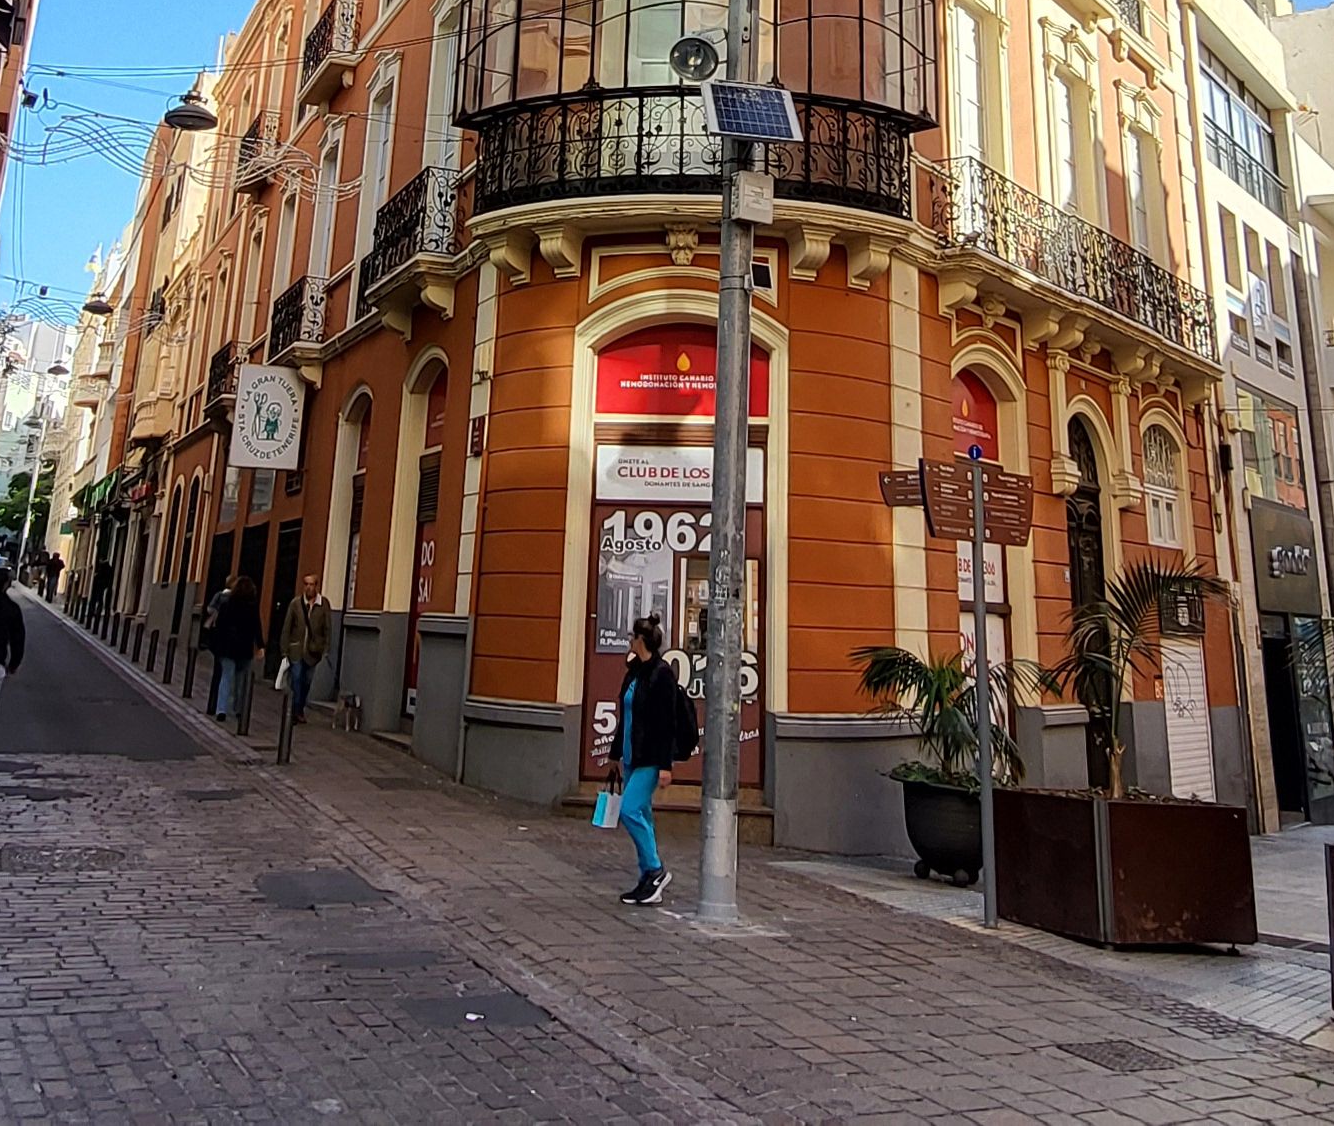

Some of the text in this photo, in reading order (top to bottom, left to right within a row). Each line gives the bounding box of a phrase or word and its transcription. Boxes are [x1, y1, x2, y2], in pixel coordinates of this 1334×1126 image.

[640, 373, 678, 381] INSTITUTO
[251, 375, 276, 389] GRAN
[278, 377, 298, 406] TIJERA
[618, 466, 710, 479] CLUB DE LOS
[602, 536, 662, 555] Agosto
[600, 629, 617, 637] Foto
